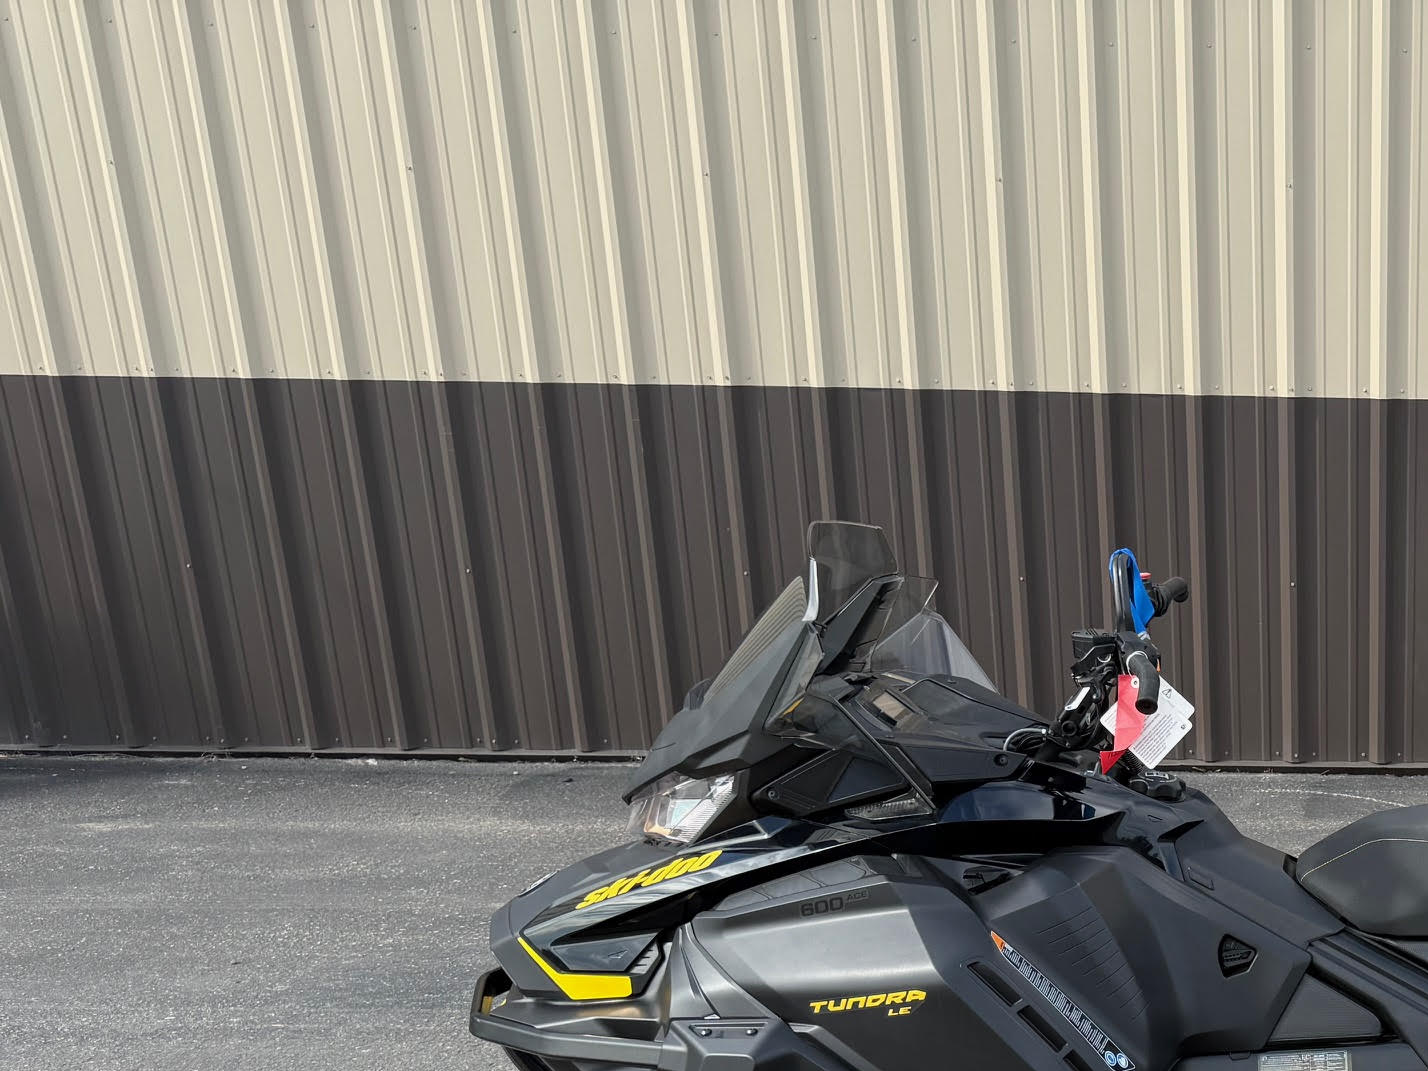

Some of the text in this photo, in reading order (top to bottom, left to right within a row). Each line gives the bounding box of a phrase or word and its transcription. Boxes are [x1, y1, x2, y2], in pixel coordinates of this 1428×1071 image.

[801, 890, 868, 917] 600 ACE
[809, 989, 927, 1014] TUNDRA
[887, 1006, 912, 1016] LE
